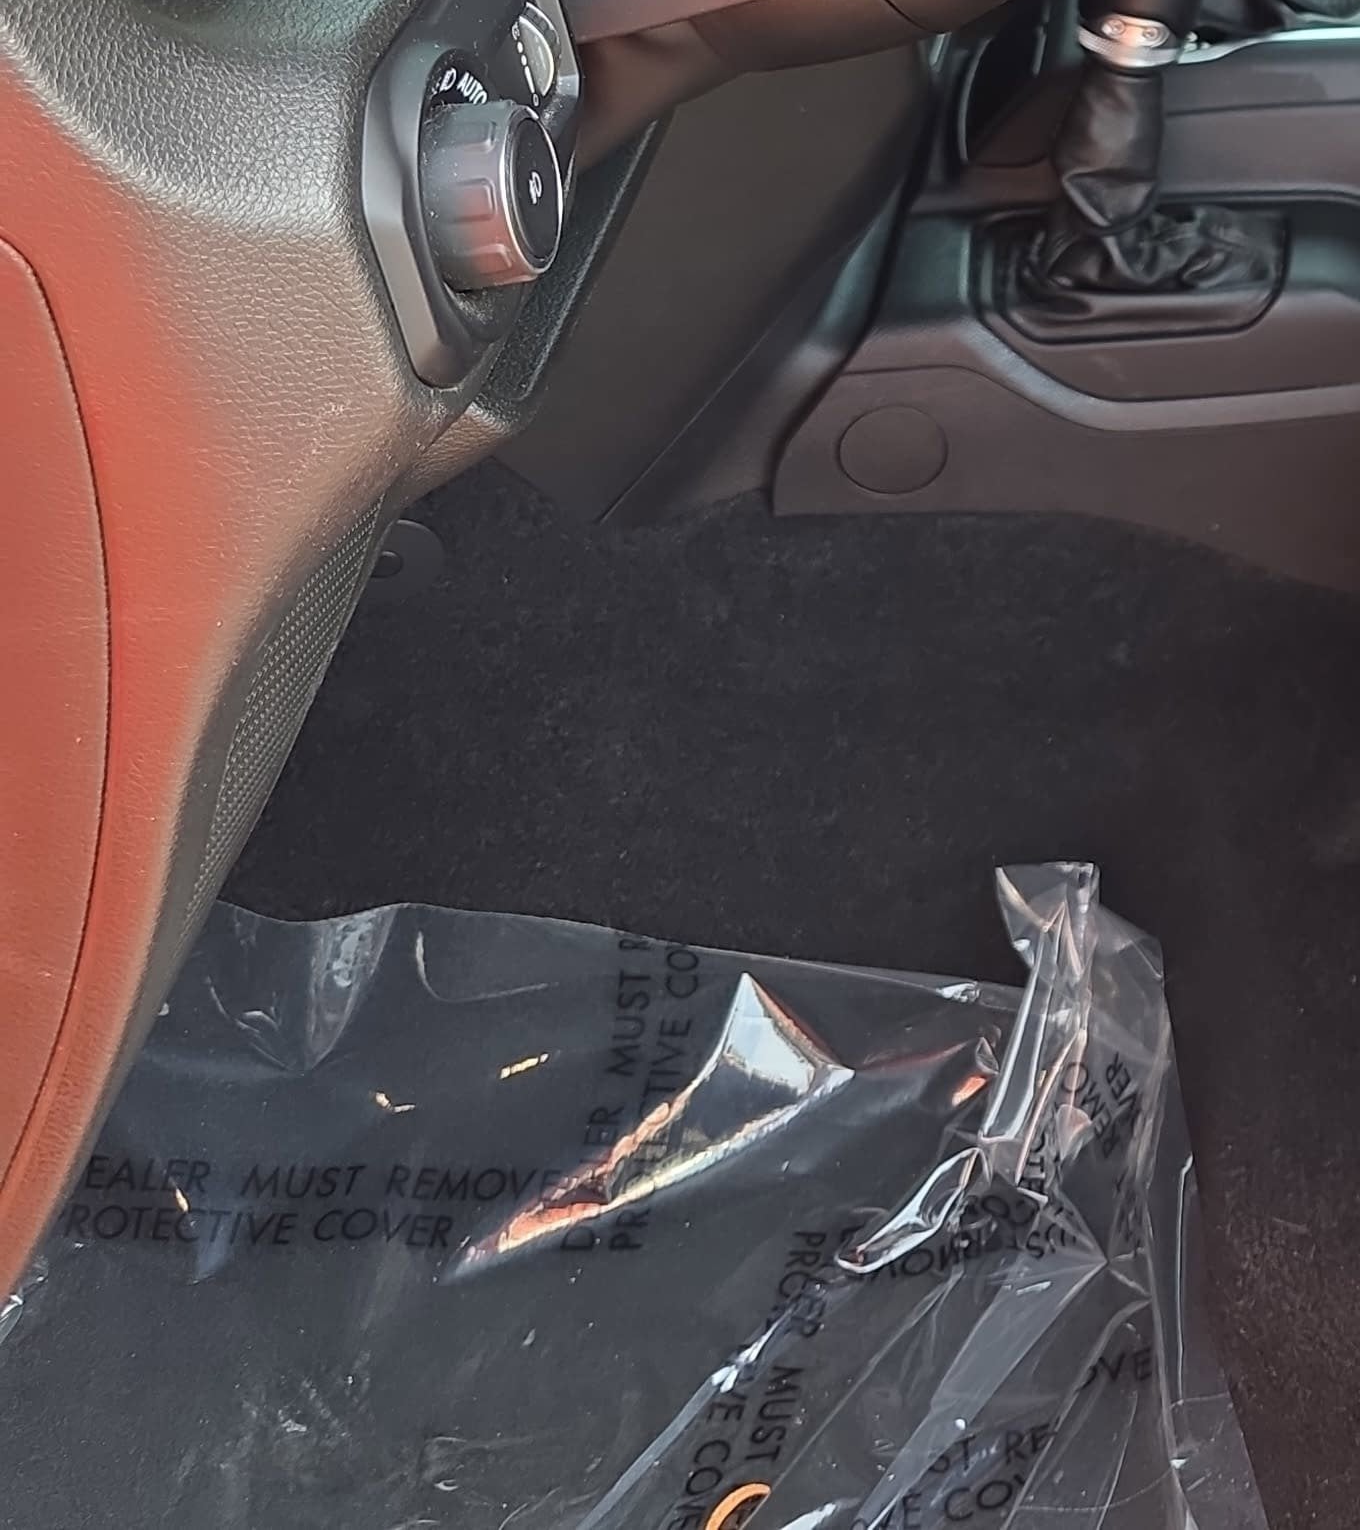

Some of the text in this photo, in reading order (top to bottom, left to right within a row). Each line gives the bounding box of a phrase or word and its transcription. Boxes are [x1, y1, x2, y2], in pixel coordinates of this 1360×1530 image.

[456, 72, 488, 105] AUTO
[607, 969, 652, 1078] MUST
[87, 1154, 212, 1193] EALER
[241, 1163, 366, 1200] MUST
[312, 1205, 456, 1251] COVER
[746, 1365, 804, 1463] MUST
